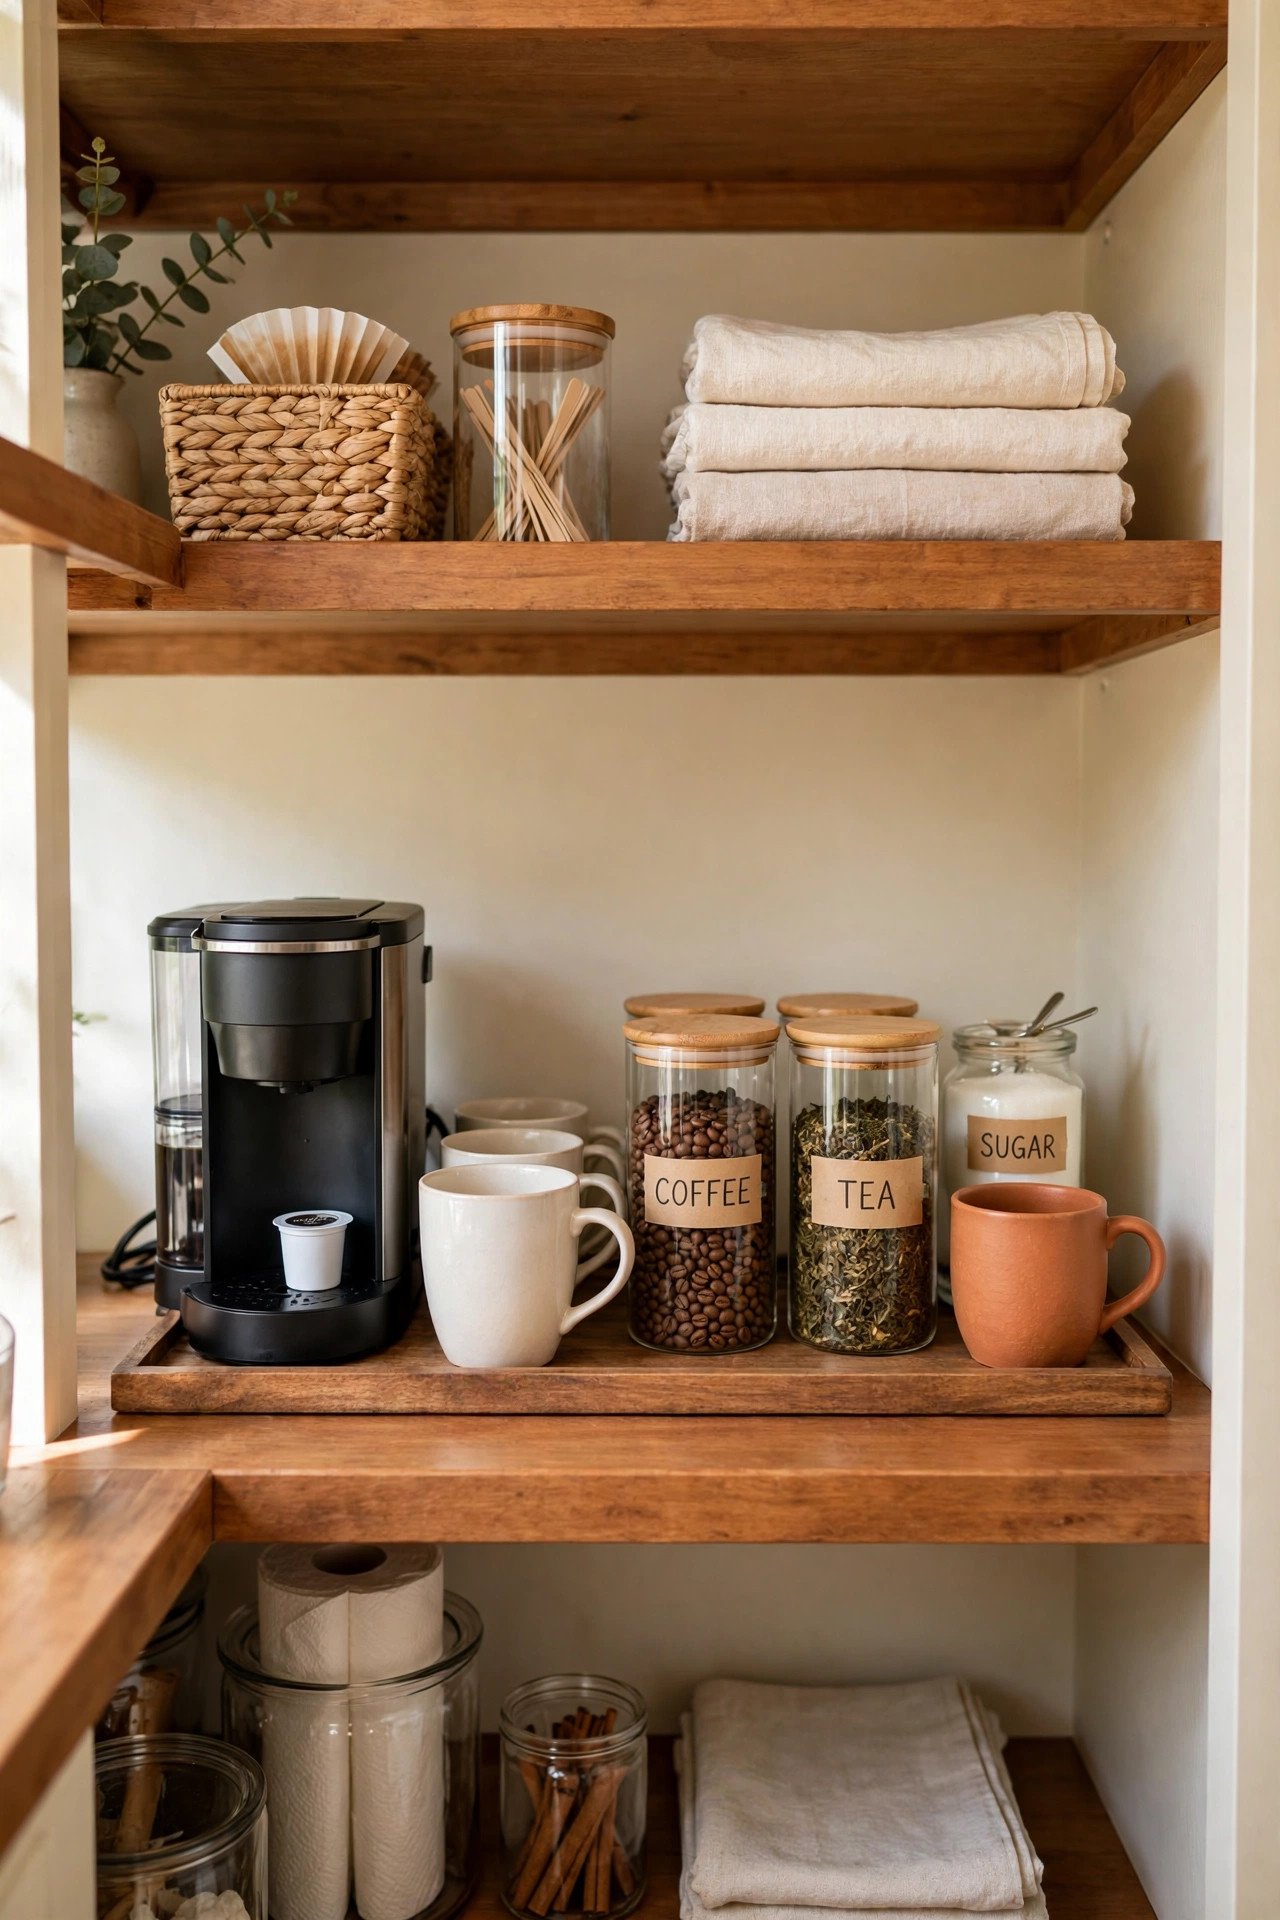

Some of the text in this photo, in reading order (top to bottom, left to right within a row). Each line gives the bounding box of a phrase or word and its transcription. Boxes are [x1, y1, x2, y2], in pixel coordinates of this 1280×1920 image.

[981, 1132, 1055, 1159] SUGAR
[655, 1176, 751, 1207] COFFEE
[837, 1179, 895, 1210] TEA
